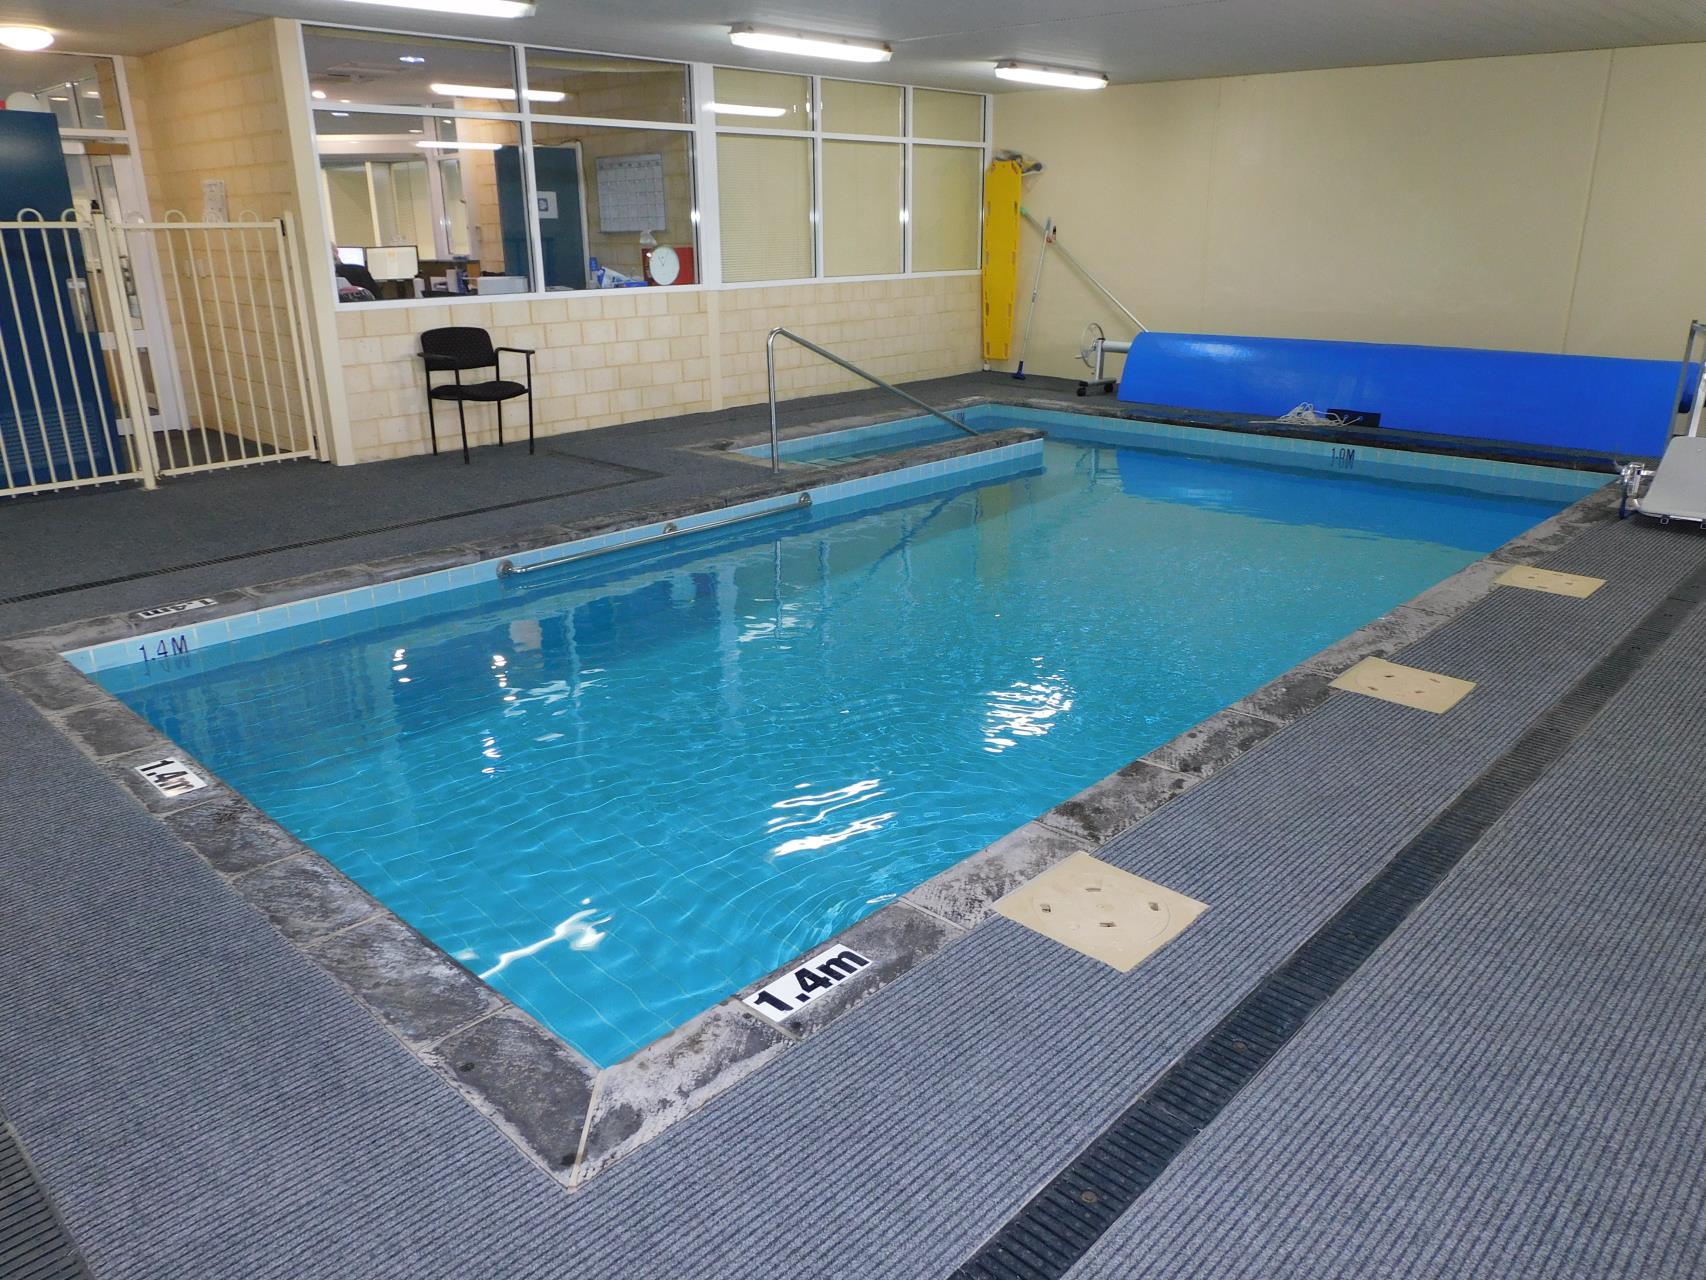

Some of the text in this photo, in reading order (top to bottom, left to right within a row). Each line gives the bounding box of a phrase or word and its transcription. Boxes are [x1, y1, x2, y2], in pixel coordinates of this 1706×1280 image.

[1331, 447, 1355, 461] 1.0M
[139, 635, 188, 661] 1.4M
[140, 760, 195, 794] 1.4m
[754, 950, 870, 1012] 1.4m
